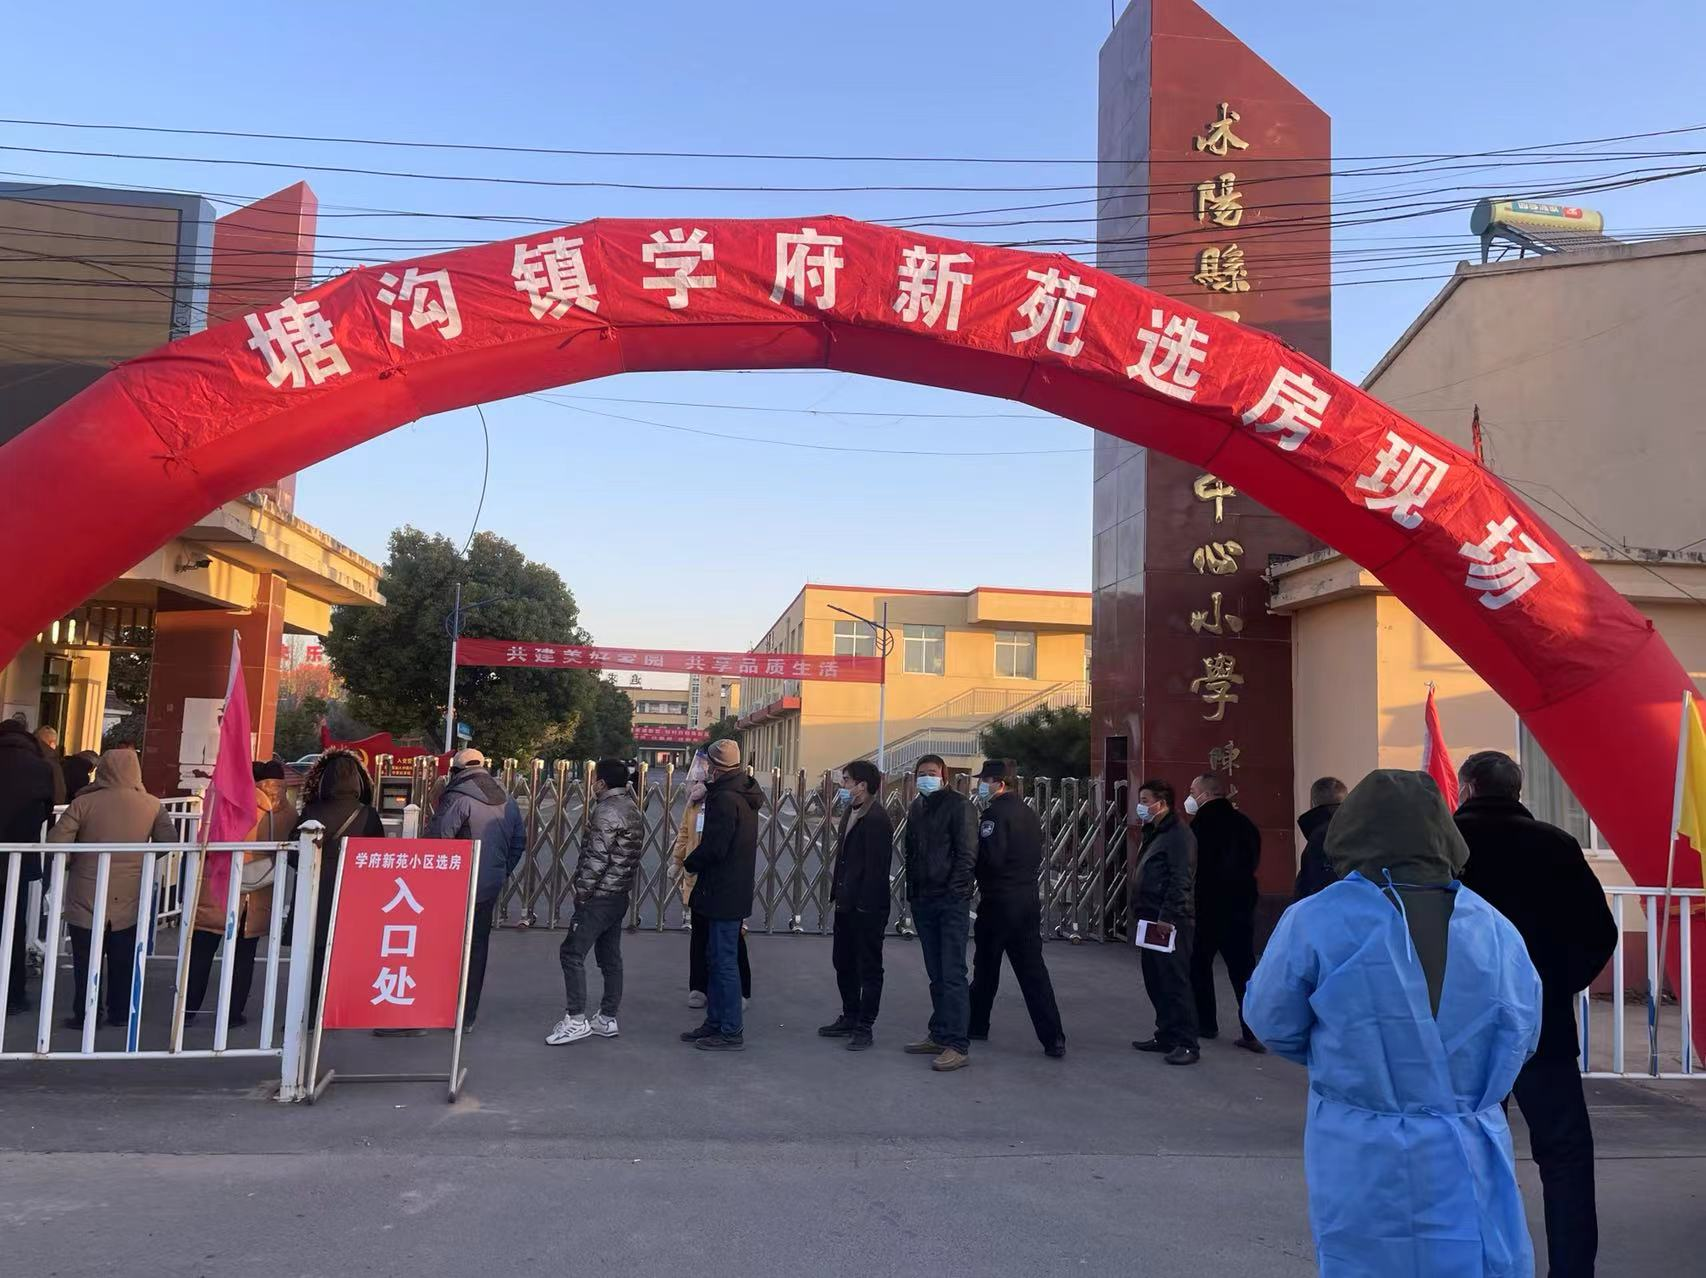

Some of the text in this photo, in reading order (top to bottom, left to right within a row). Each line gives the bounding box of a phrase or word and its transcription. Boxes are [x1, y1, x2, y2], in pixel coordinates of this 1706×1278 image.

[1194, 101, 1251, 323] 沭陽縣
[244, 226, 1556, 612] 塘沟镇学府新苑选房现场
[685, 655, 840, 678] 共享品质生活
[355, 852, 462, 870] 学府新苑小区选房
[370, 876, 425, 1006] 入口处
